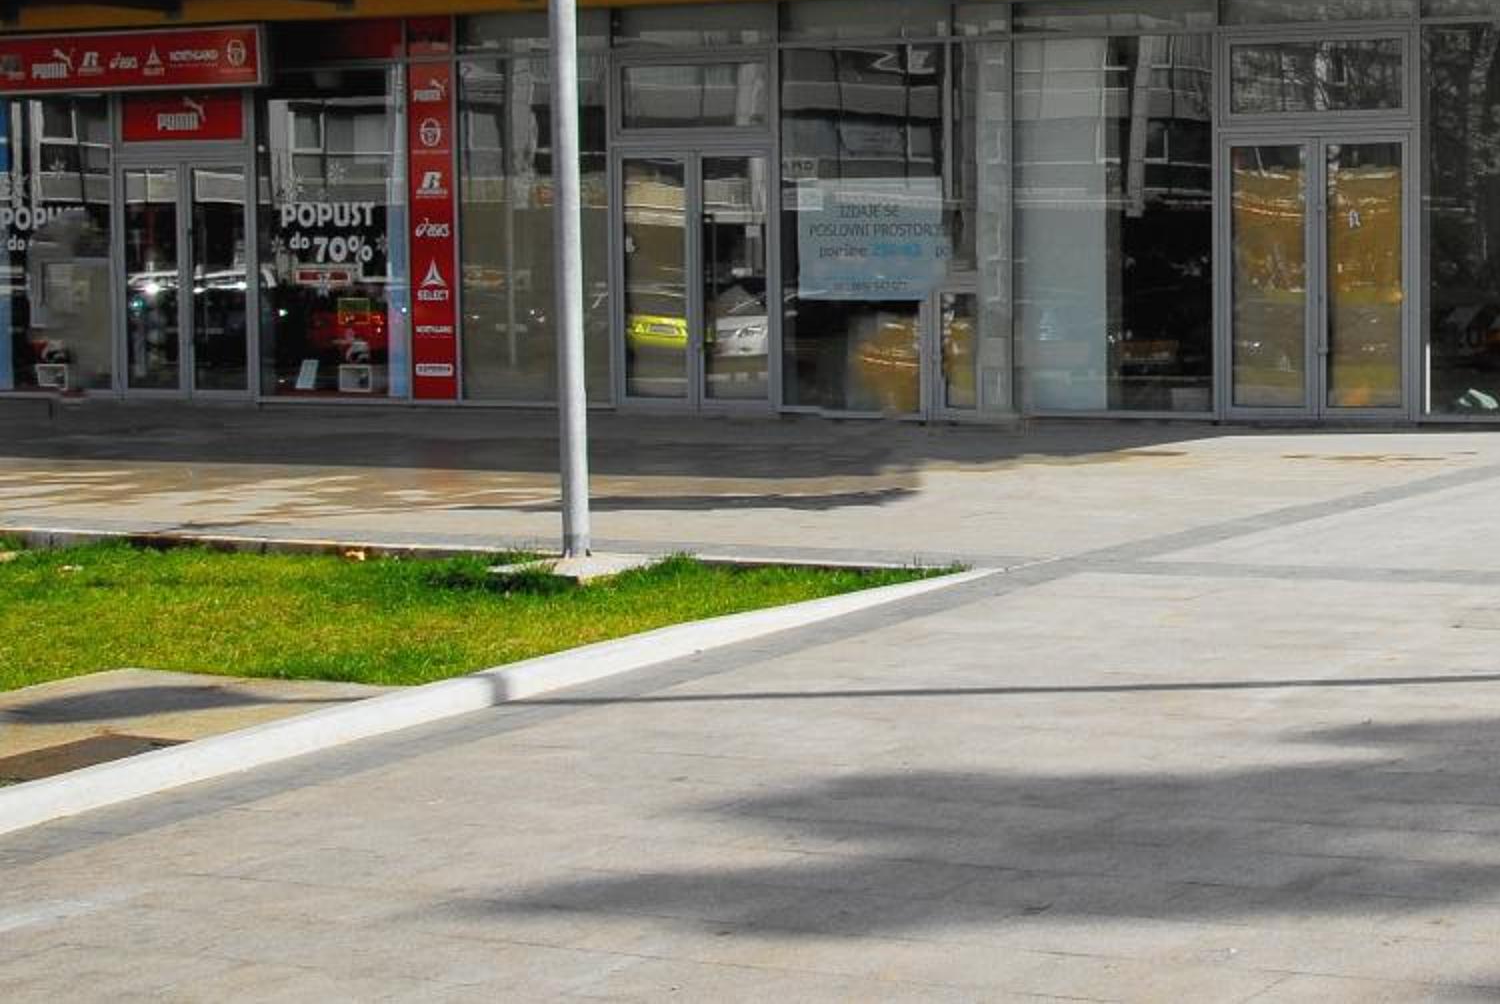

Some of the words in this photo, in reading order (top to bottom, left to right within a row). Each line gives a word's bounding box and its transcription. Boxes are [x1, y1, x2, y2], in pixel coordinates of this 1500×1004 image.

[281, 202, 375, 227] POPUST
[290, 232, 310, 249] do
[313, 236, 373, 263] 70%
